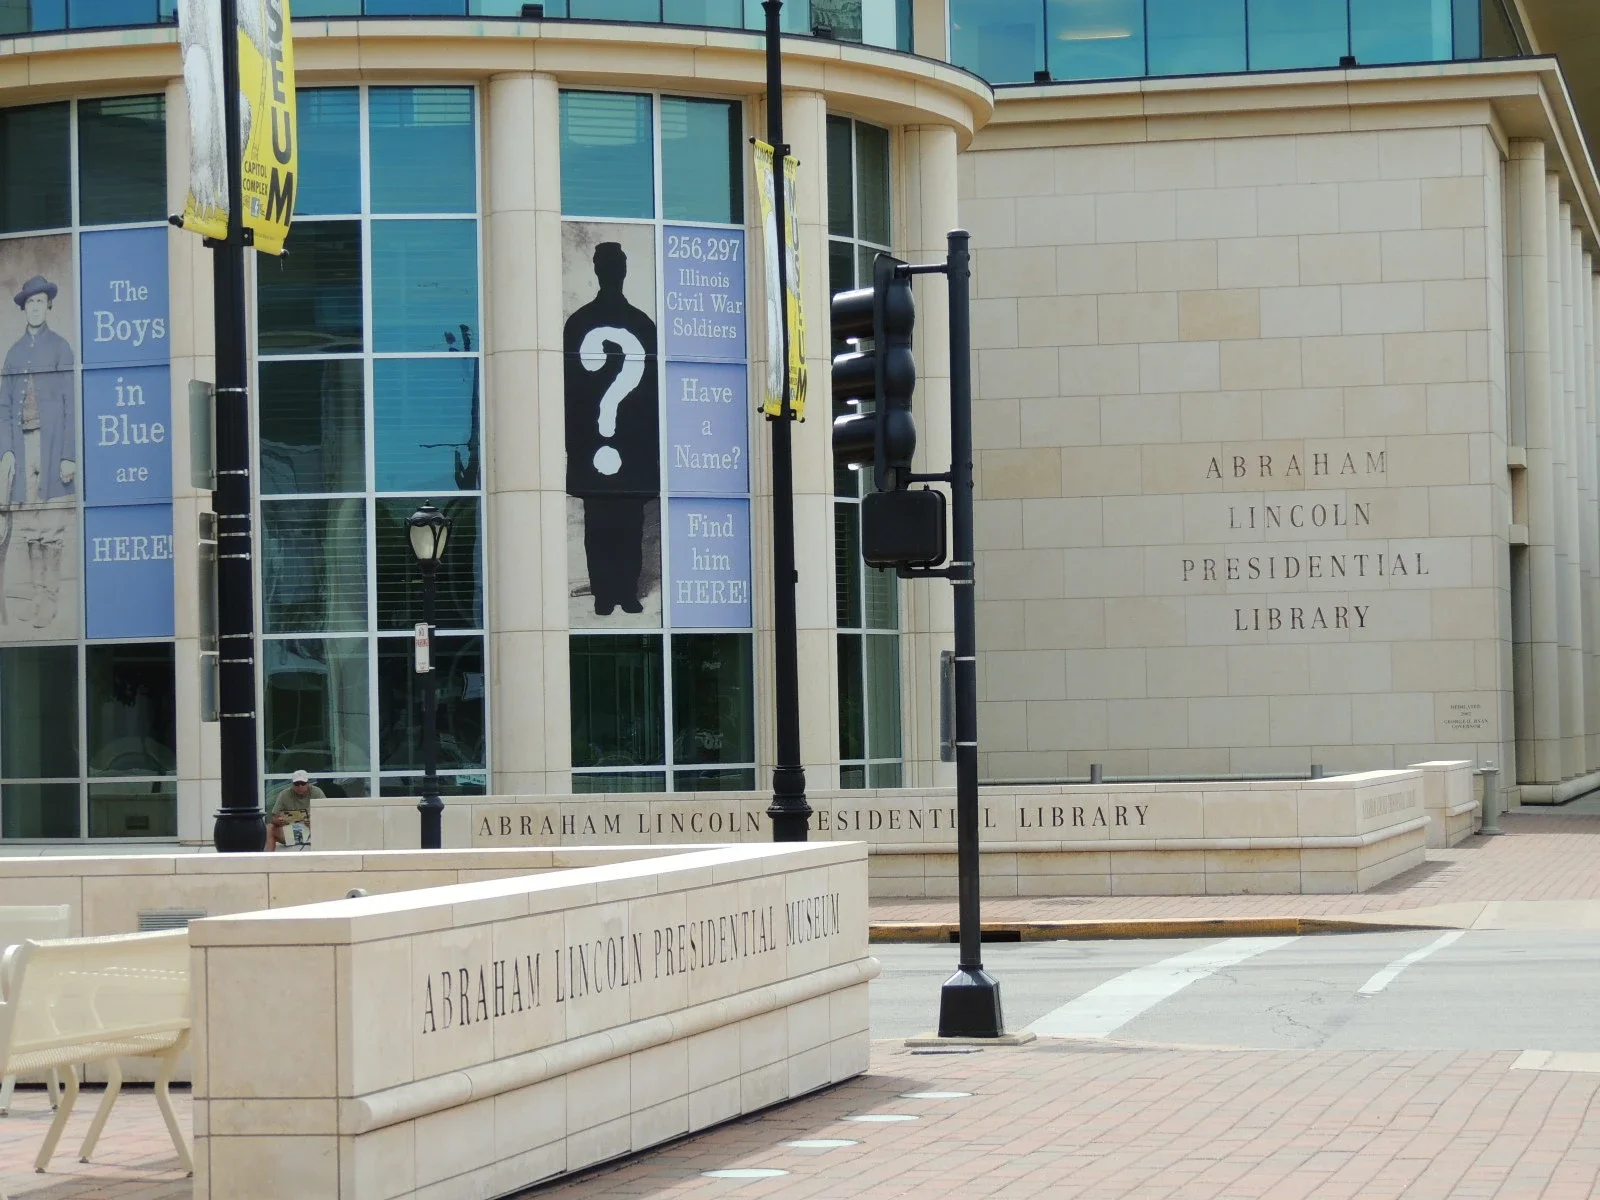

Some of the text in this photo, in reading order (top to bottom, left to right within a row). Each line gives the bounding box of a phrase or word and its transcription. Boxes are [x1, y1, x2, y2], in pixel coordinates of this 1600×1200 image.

[244, 160, 268, 178] CAPITOL
[242, 177, 269, 196] COMPLEX
[667, 235, 740, 262] 256,297
[679, 268, 730, 288] Illinois
[109, 280, 149, 302] The
[666, 291, 743, 314] Civil War
[93, 310, 166, 347] Boys
[673, 317, 737, 339] Soldiers
[115, 376, 146, 406] in
[681, 378, 733, 403] Have
[97, 413, 165, 446] Blue
[701, 420, 713, 436] a
[674, 444, 741, 470] Name?
[1206, 451, 1387, 479] ABRAHAM
[116, 466, 149, 483] are
[687, 513, 735, 538] Find
[1229, 503, 1371, 529] LINCOLN
[92, 535, 173, 562] HERE!
[692, 547, 731, 571] him
[1181, 553, 1430, 581] PRESIDENTIAL
[676, 580, 748, 604] HERE!
[1234, 605, 1370, 631] LIBRARY
[479, 805, 1150, 837] ABRAHAM LINCOLN ESIDENTIL LIBRARY
[422, 893, 841, 1034] ABRAHAM LINCOLN PRESIDENTIAL MUSEUM
